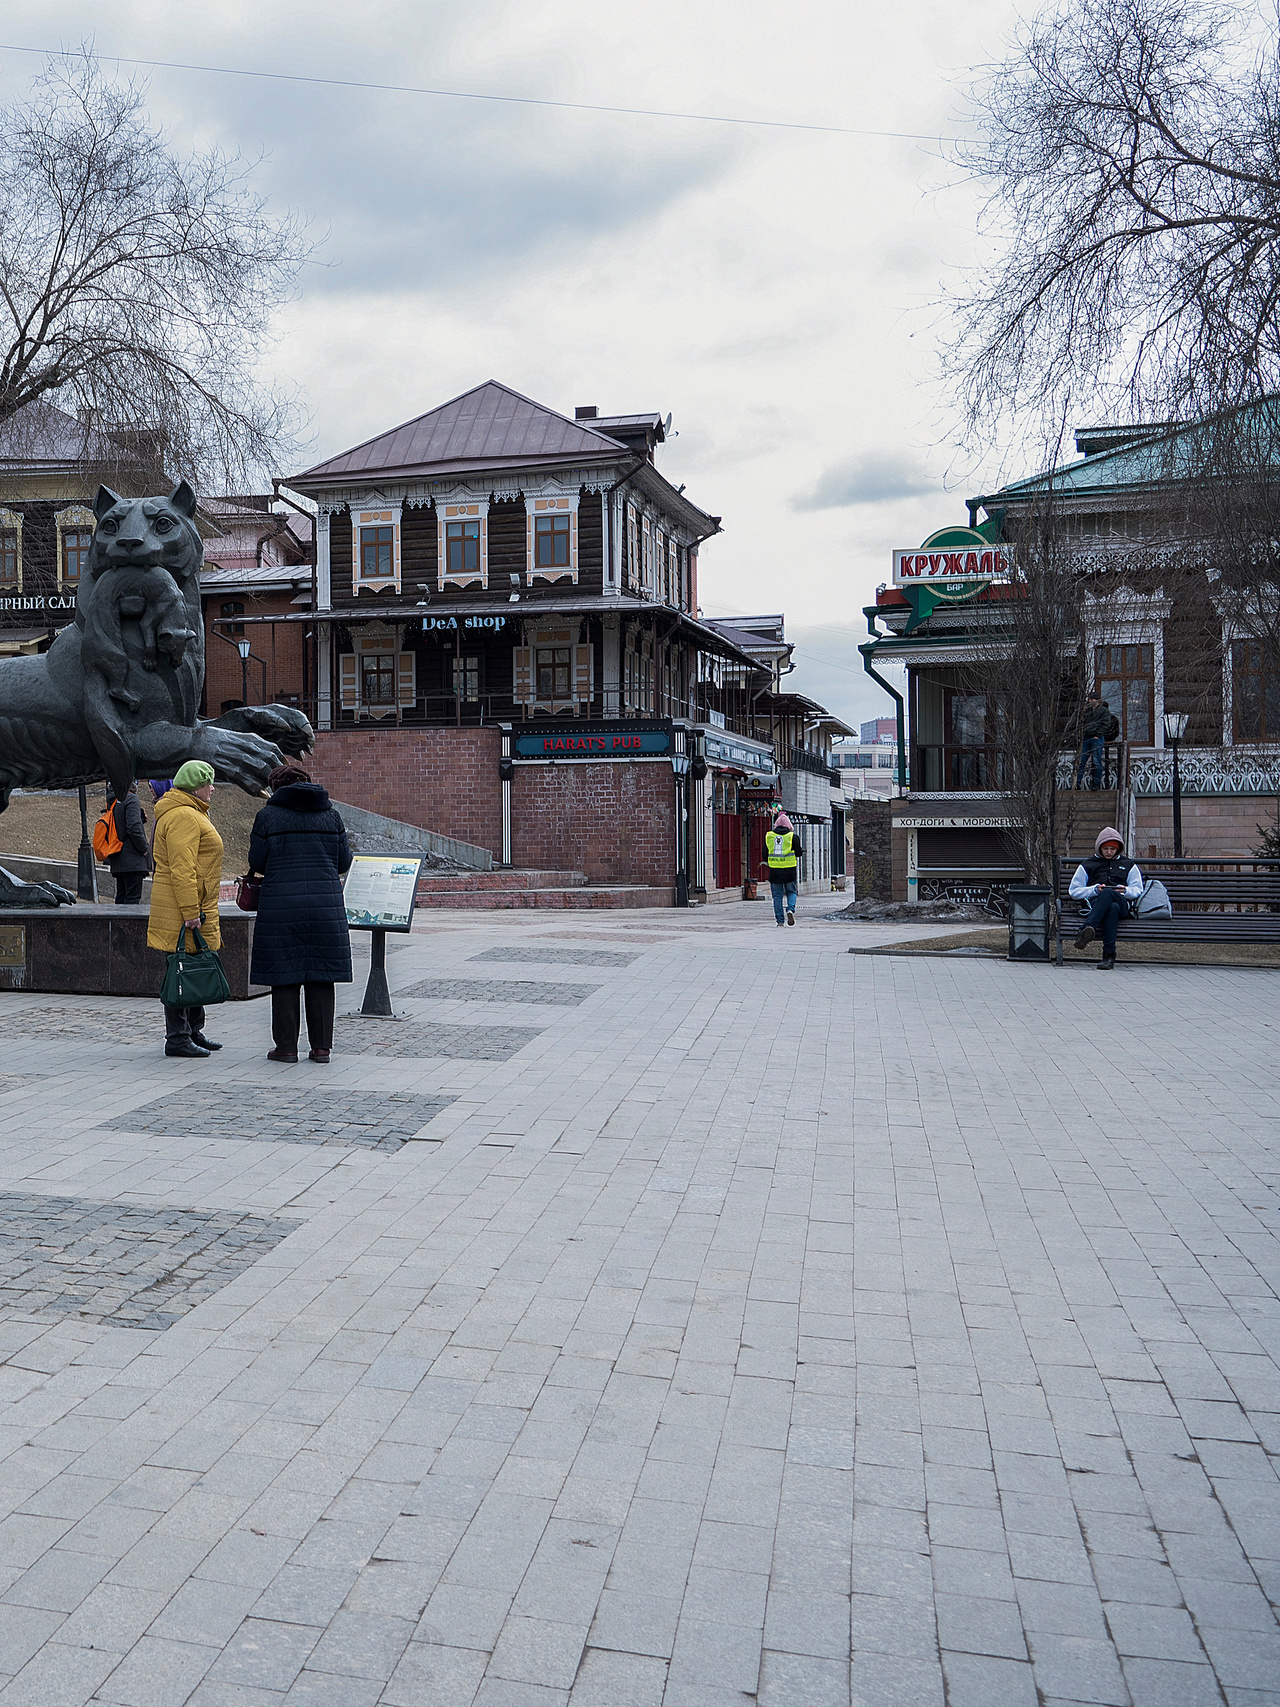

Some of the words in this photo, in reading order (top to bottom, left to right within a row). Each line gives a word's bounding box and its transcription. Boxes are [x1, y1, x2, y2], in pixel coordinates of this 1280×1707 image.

[900, 551, 1008, 577] КРУЖАЛЬ
[946, 583, 964, 591] БАР
[48, 596, 76, 609] САЛ
[421, 616, 458, 630] DeA
[464, 615, 506, 631] shop
[543, 737, 606, 750] HARAT'S
[612, 736, 642, 749] PUB
[900, 818, 945, 827] ХОТ-ДОГИ
